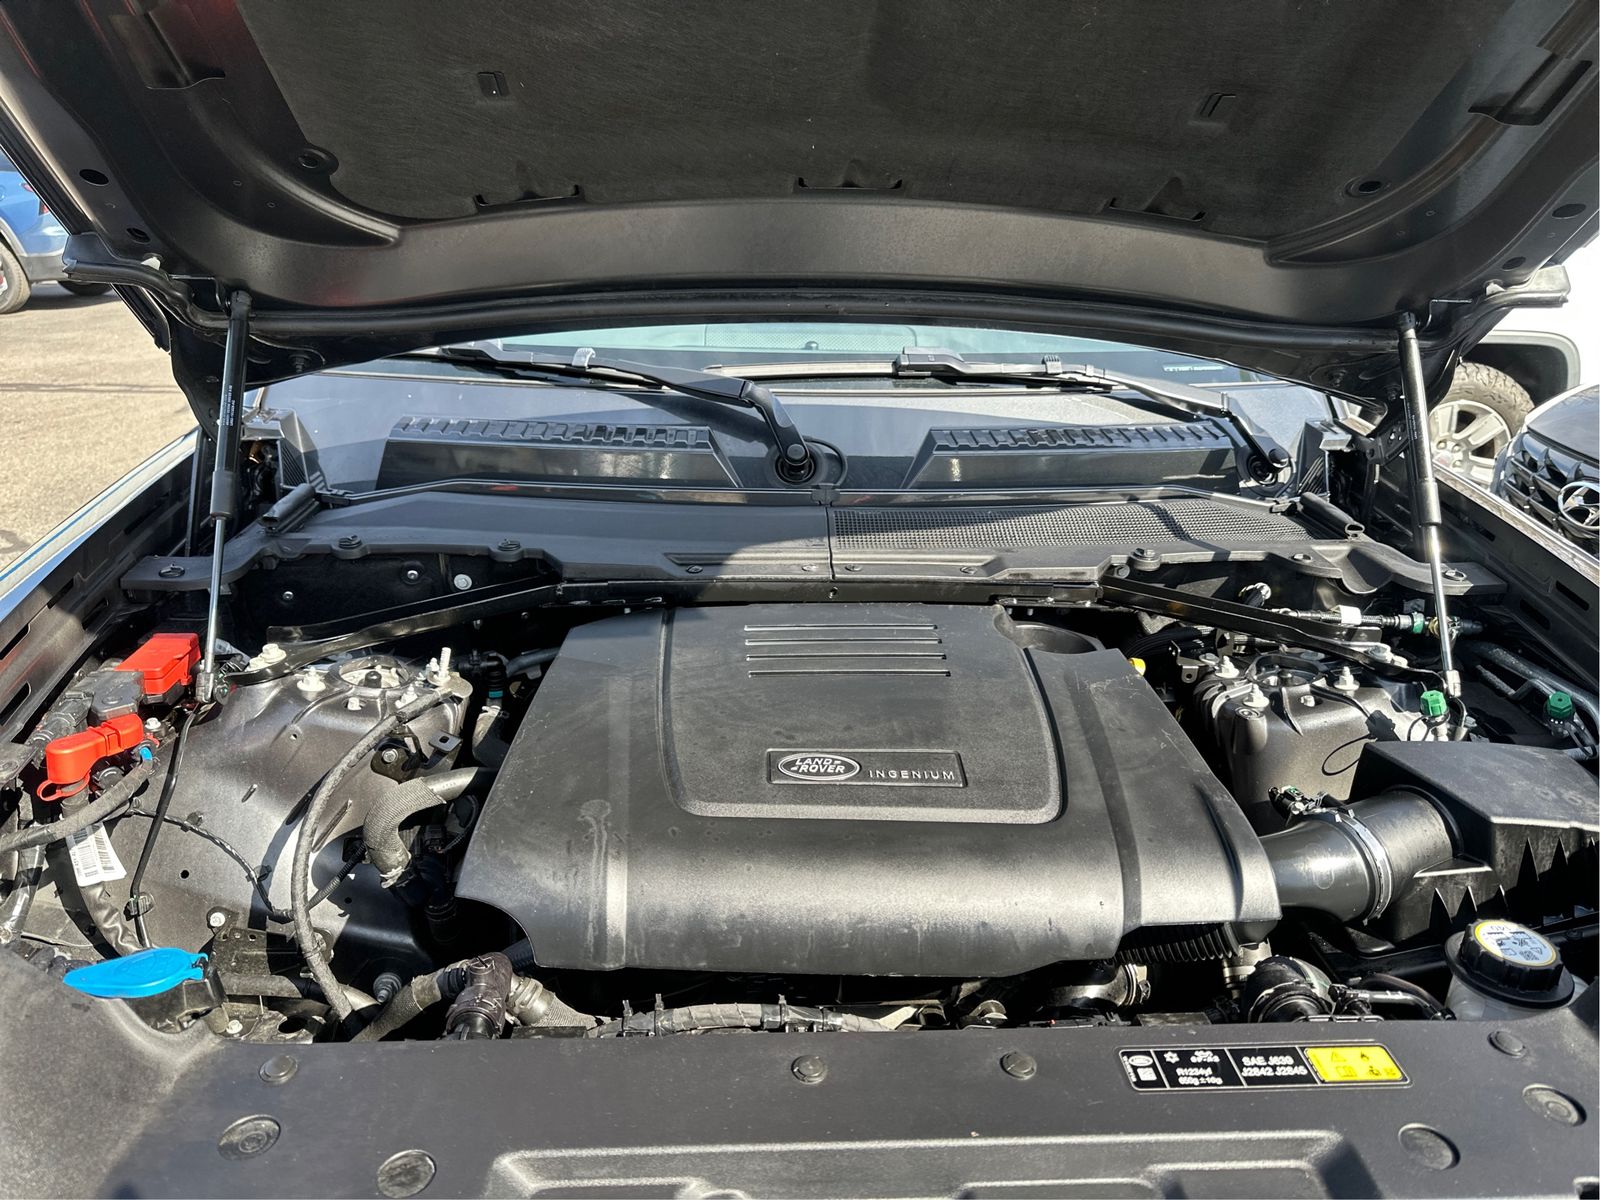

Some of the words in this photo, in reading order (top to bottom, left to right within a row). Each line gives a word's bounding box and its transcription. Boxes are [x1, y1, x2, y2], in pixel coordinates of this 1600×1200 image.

[799, 764, 846, 774] ROVER
[868, 769, 955, 780] INGENIUM
[1241, 1056, 1268, 1066] SAE
